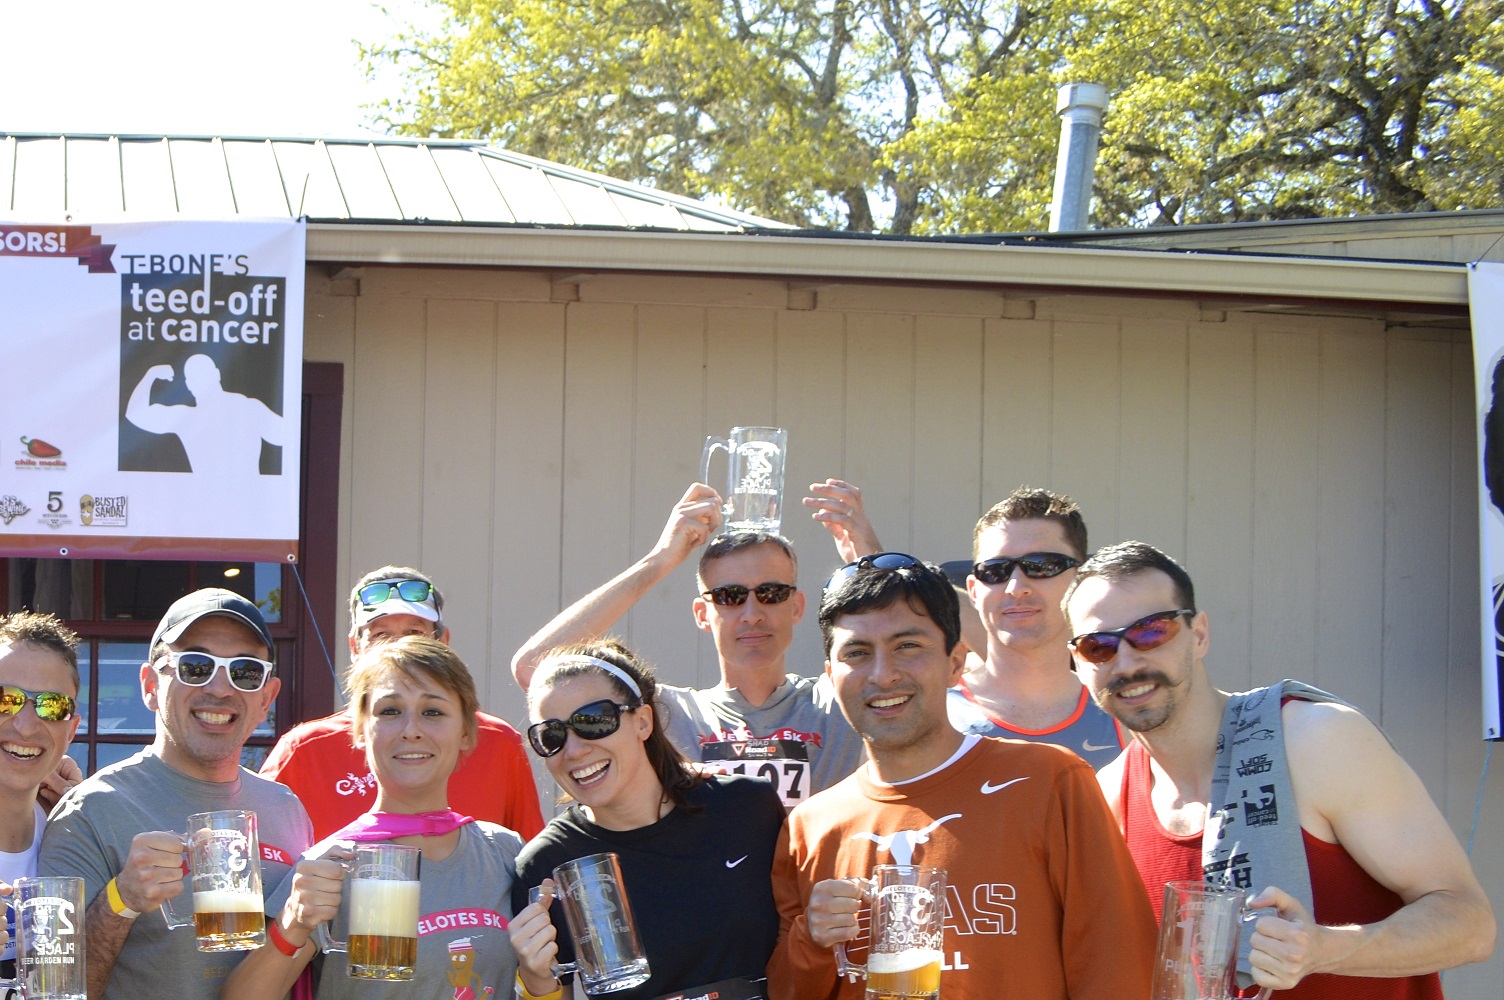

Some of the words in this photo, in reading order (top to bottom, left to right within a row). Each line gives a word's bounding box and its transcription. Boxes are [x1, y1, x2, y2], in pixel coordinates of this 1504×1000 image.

[121, 253, 249, 275] T-BONE'S
[130, 282, 277, 317] teed-off
[128, 318, 155, 341] at
[160, 317, 278, 344] cancer
[39, 459, 67, 467] media
[48, 491, 63, 513] 5
[94, 496, 126, 507] BUSTED
[95, 506, 126, 518] SANDAL
[783, 731, 802, 741] 5K
[264, 847, 284, 862] 5K
[484, 913, 502, 929] 5K
[35, 957, 61, 965] GARDEN
